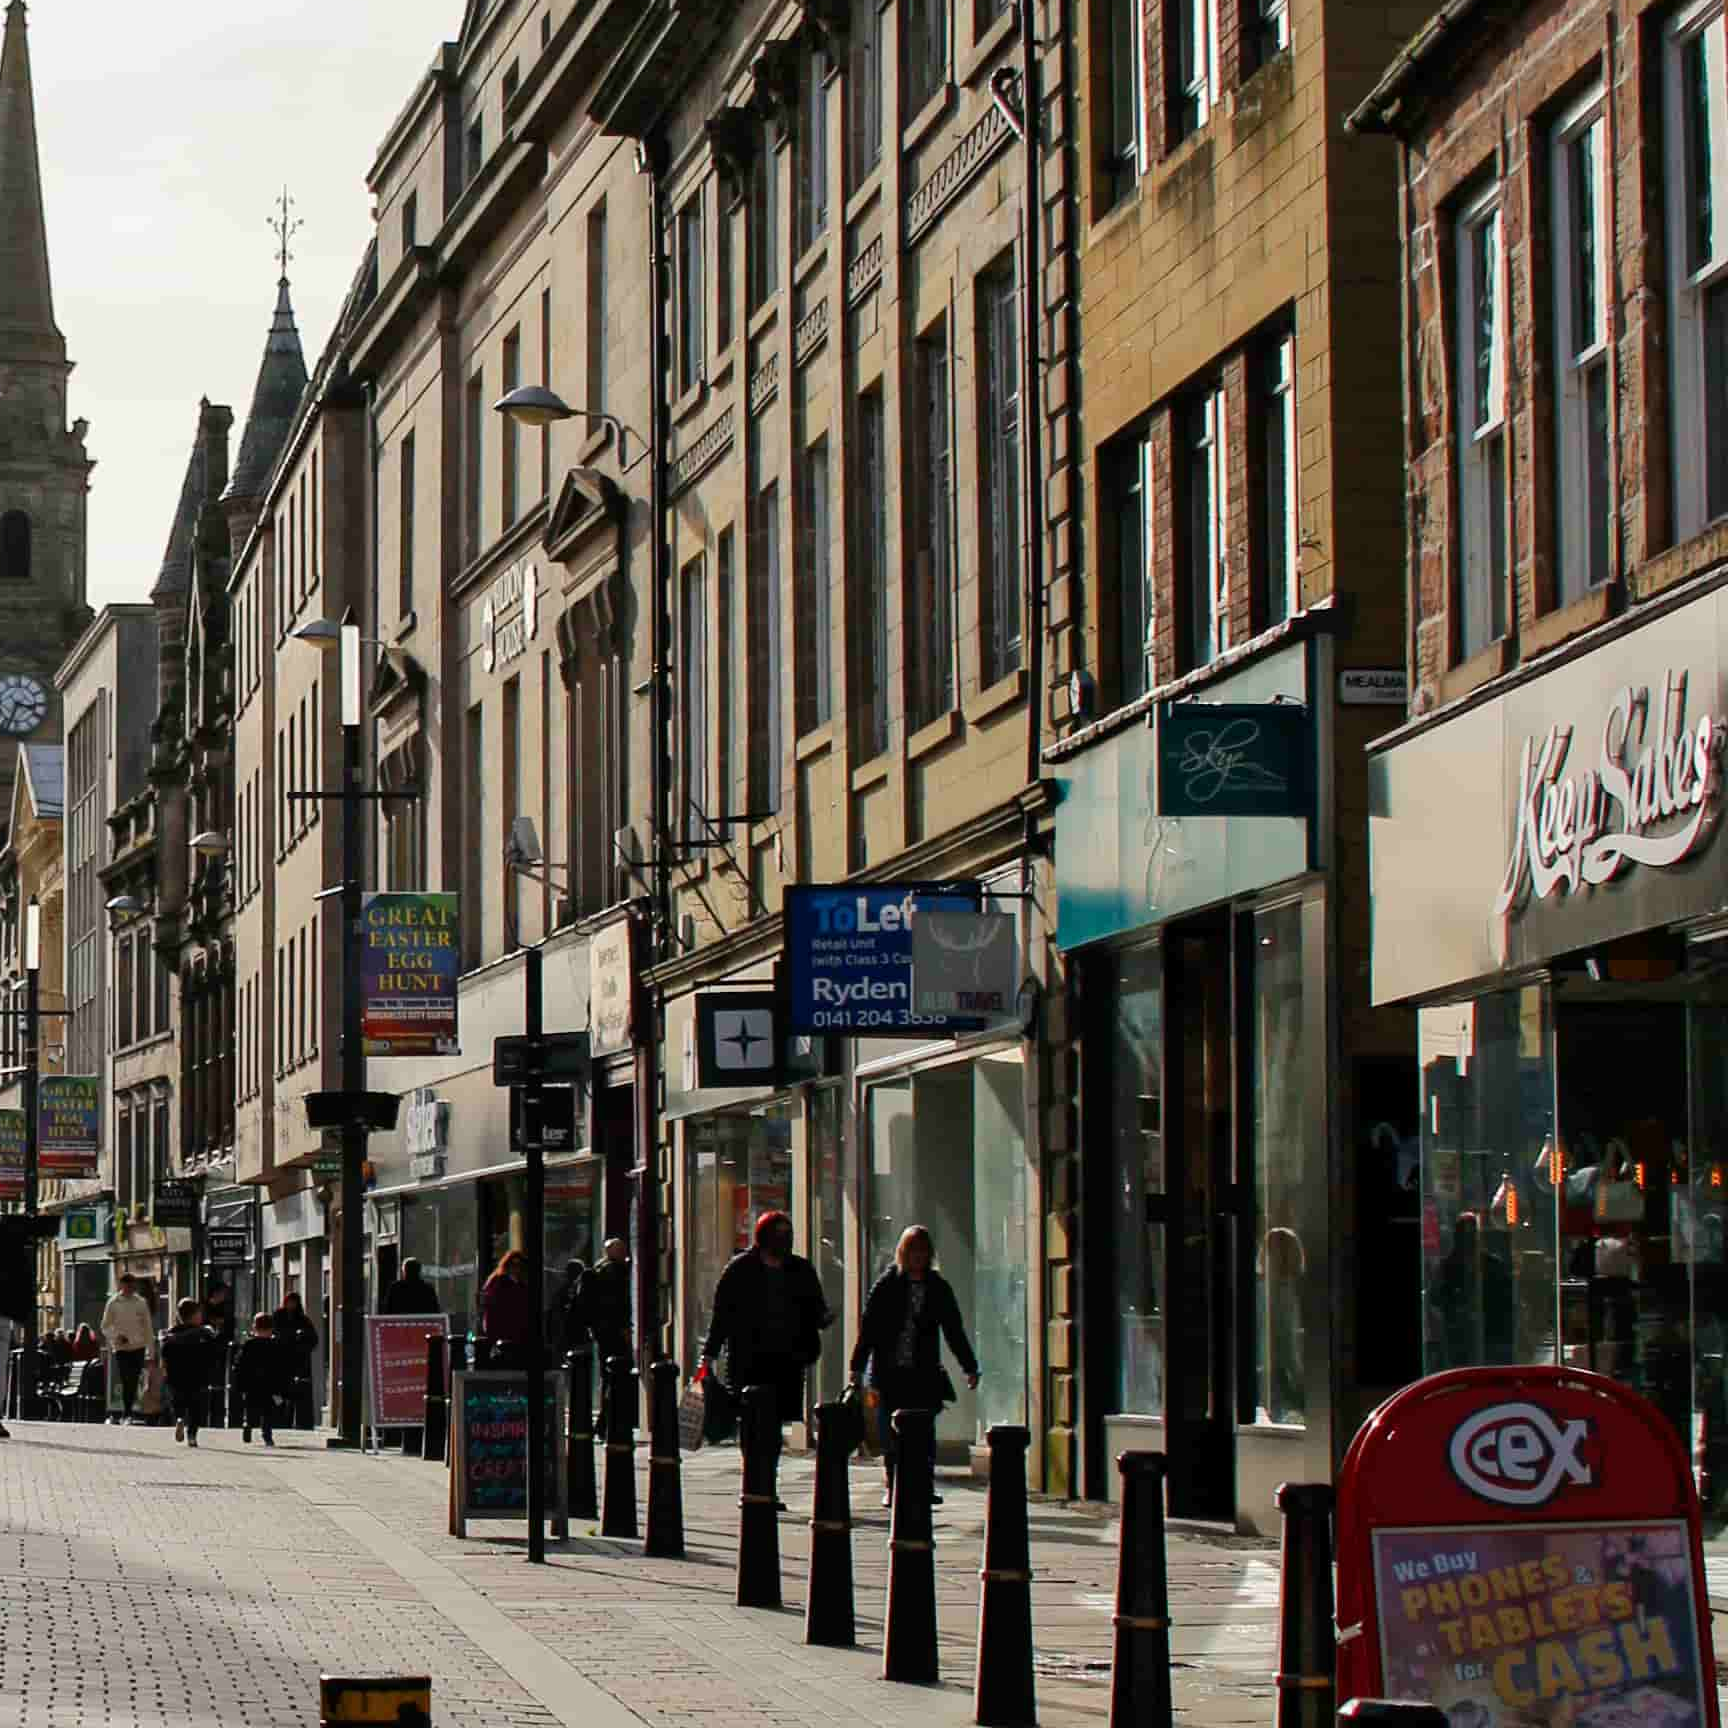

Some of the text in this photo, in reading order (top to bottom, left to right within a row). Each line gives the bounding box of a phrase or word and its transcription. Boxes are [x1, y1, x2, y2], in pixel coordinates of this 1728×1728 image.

[1494, 668, 1715, 912] Keep Sakes
[368, 905, 449, 926] GREAT
[369, 930, 450, 948] EASTER
[386, 952, 432, 970] EGG
[845, 953, 878, 967] Class
[879, 952, 889, 965] 3
[376, 974, 445, 992] HUNT
[812, 975, 908, 1007] Ryden
[812, 1009, 852, 1027] 0141
[855, 1008, 894, 1025] 204
[213, 1238, 243, 1249] LUSH
[1391, 1551, 1479, 1583] We Buy
[1400, 1553, 1594, 1625] PHONES &
[1438, 1582, 1634, 1657] TABLETS
[1454, 1616, 1679, 1709] for CASH
